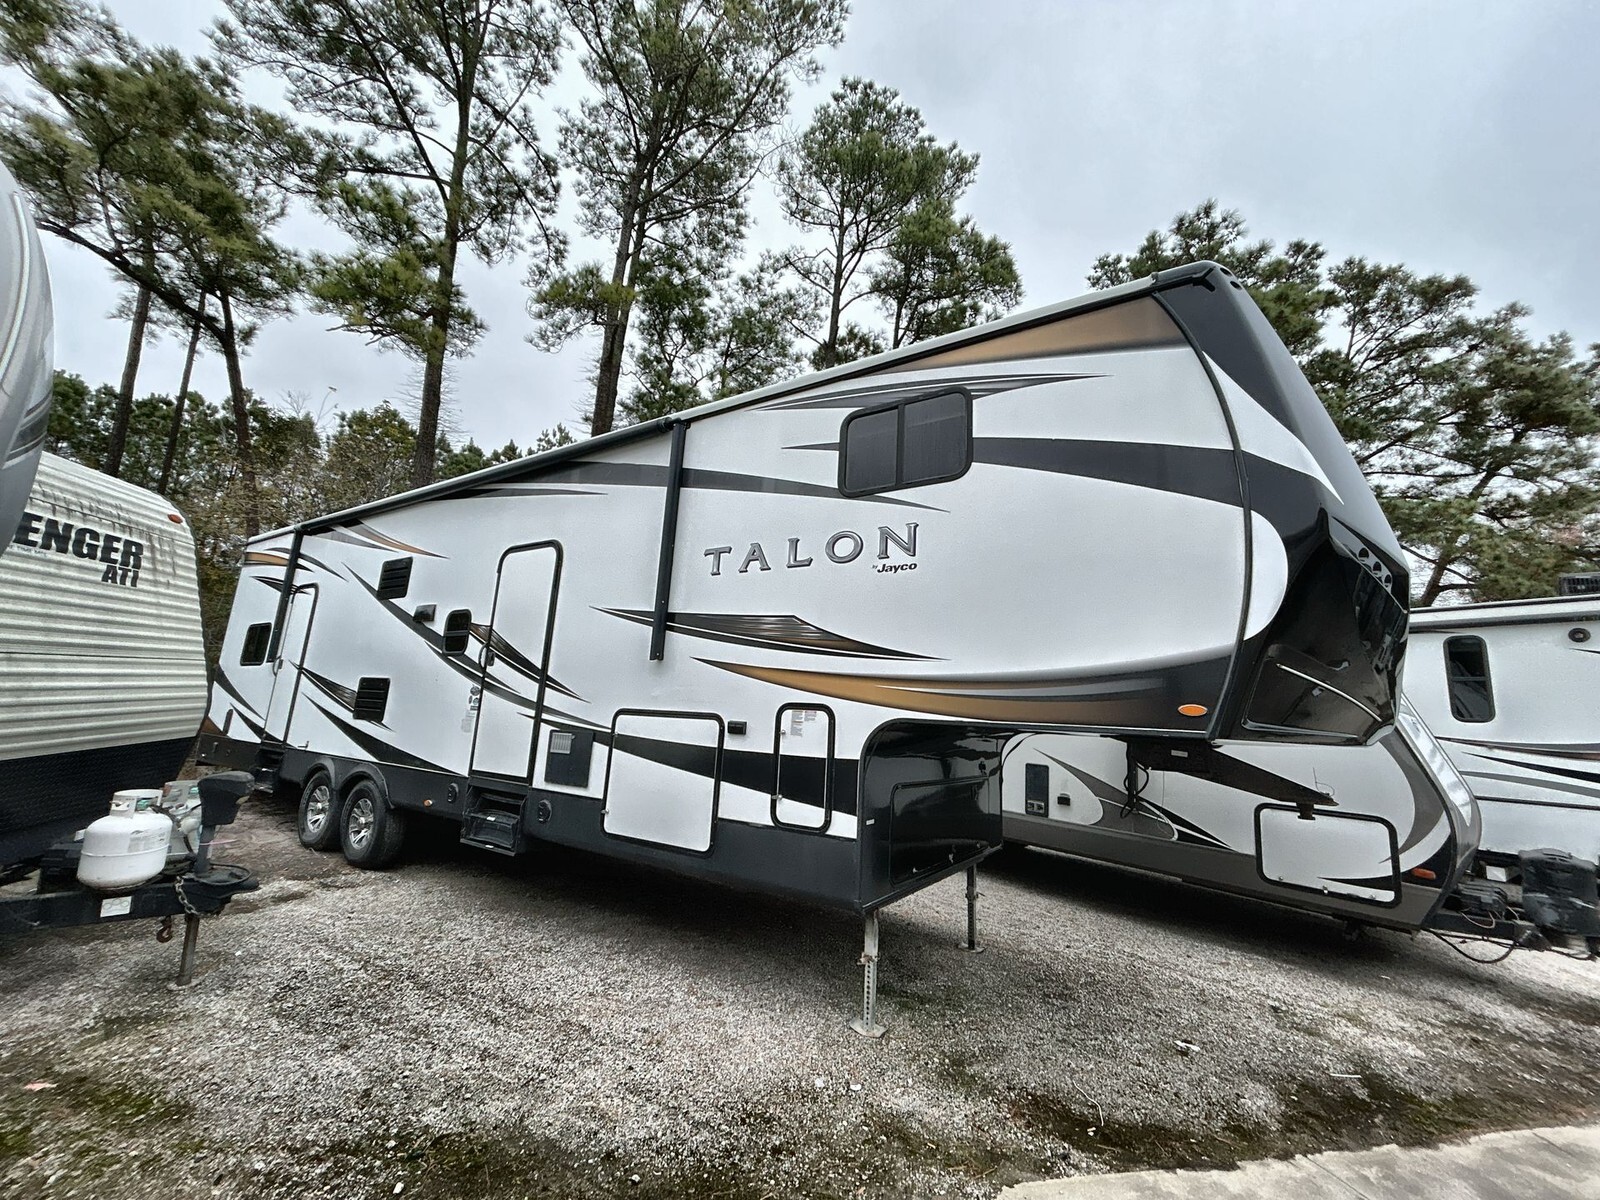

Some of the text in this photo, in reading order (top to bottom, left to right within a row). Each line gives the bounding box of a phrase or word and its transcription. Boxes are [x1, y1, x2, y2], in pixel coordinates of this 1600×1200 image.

[13, 511, 144, 570] ENGER
[703, 521, 919, 576] TALON
[101, 564, 140, 588] ATI
[877, 562, 918, 574] Jayco
